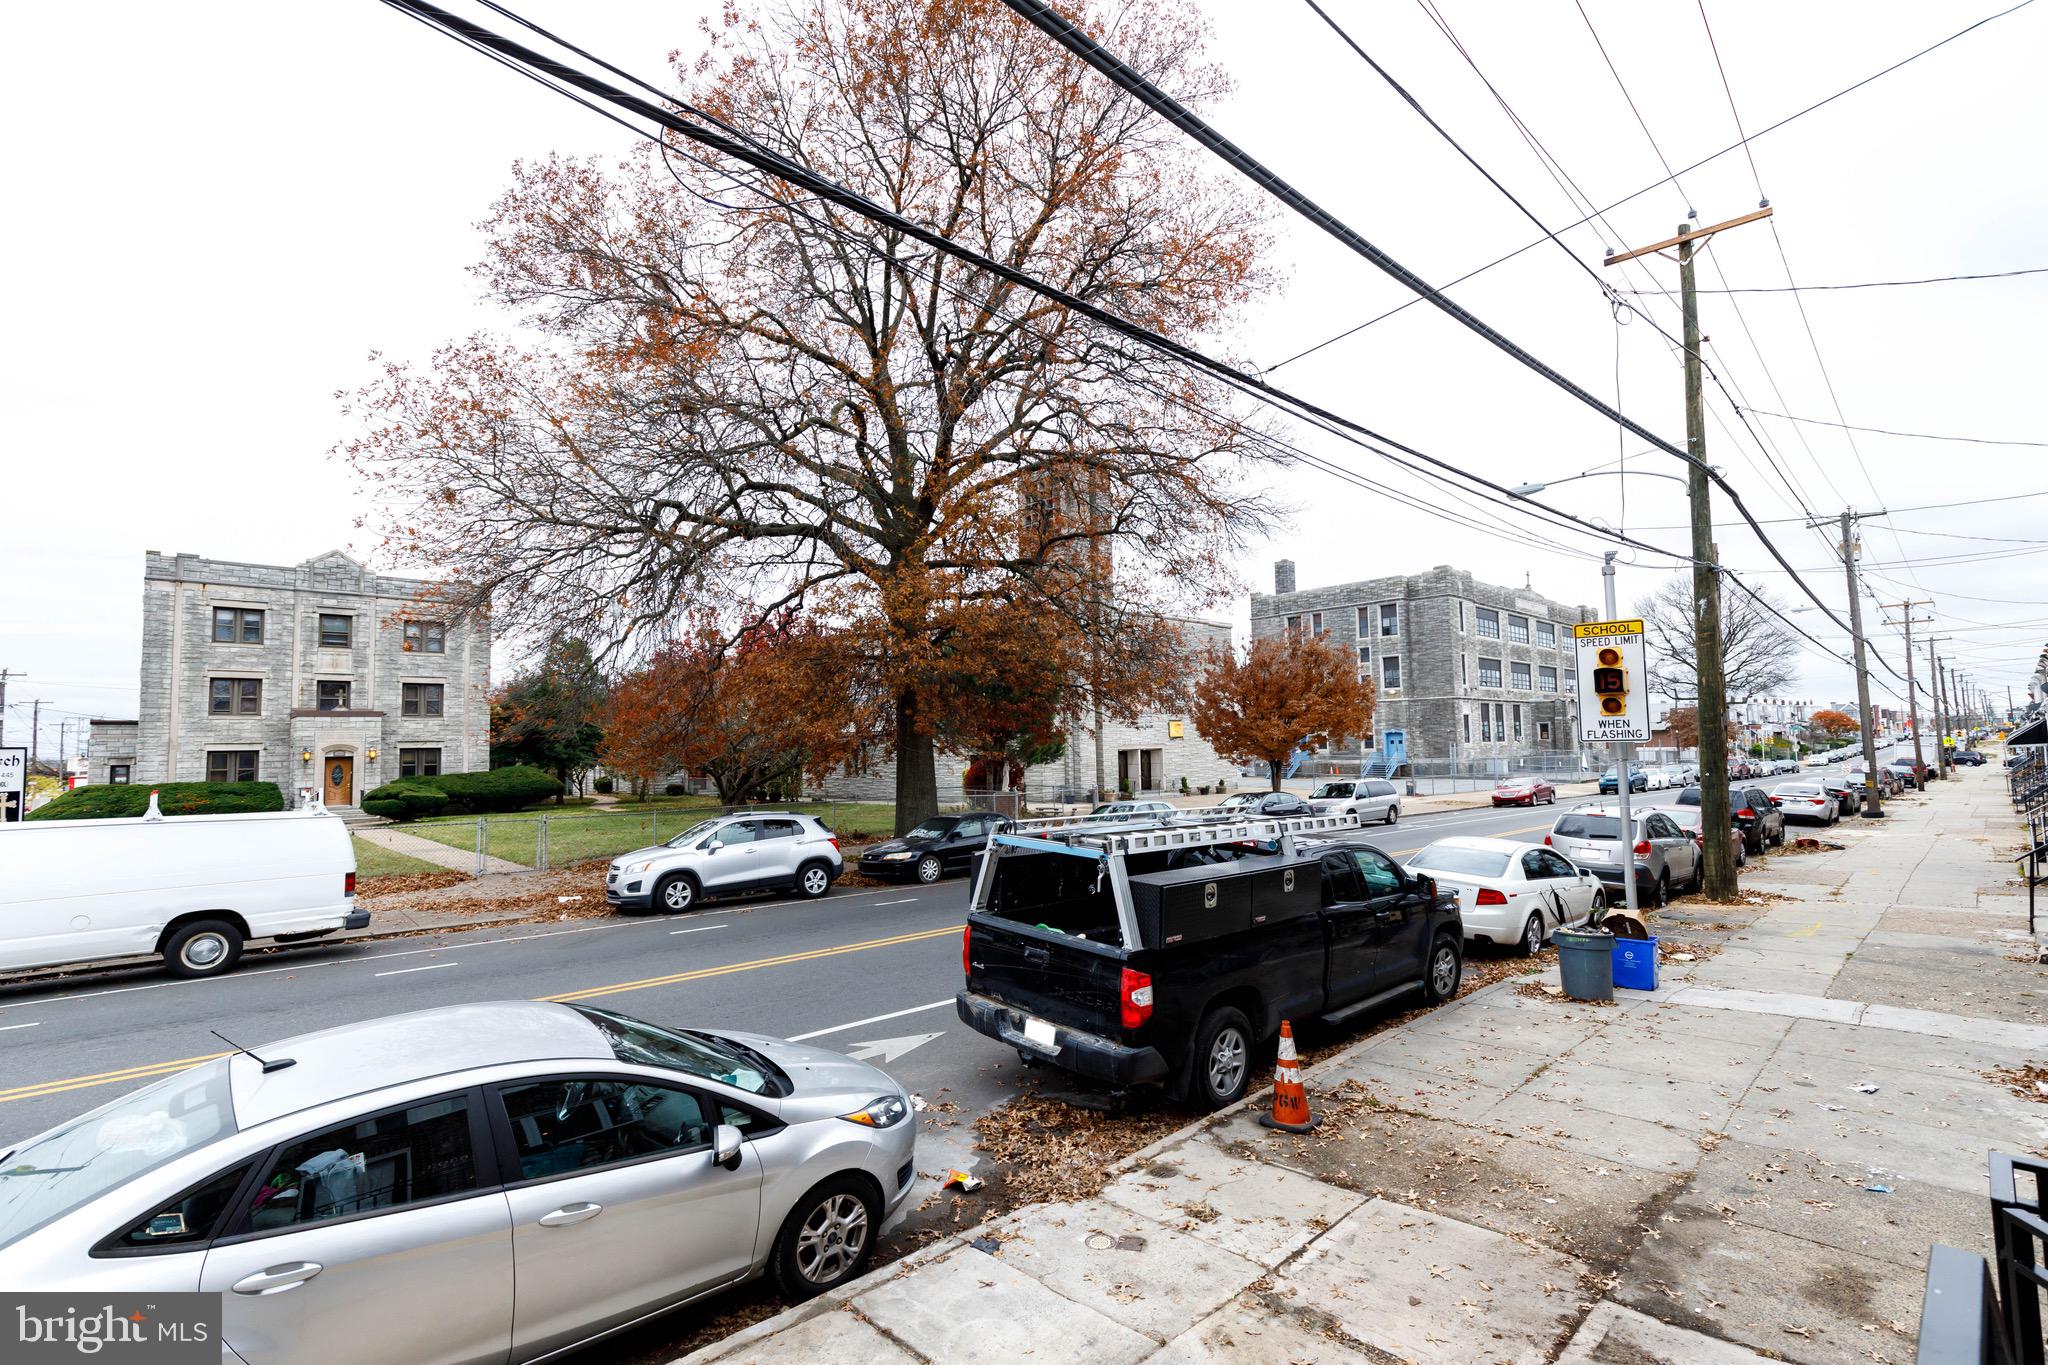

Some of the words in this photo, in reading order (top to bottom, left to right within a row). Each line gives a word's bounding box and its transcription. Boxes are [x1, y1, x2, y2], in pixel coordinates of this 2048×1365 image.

[1583, 624, 1635, 636] SCHOOL
[1580, 637, 1611, 648] SPEED
[1614, 635, 1639, 646] LIMIT
[1600, 672, 1620, 689] 15
[1598, 719, 1630, 729] WHEN
[1587, 729, 1643, 739] FLASHING
